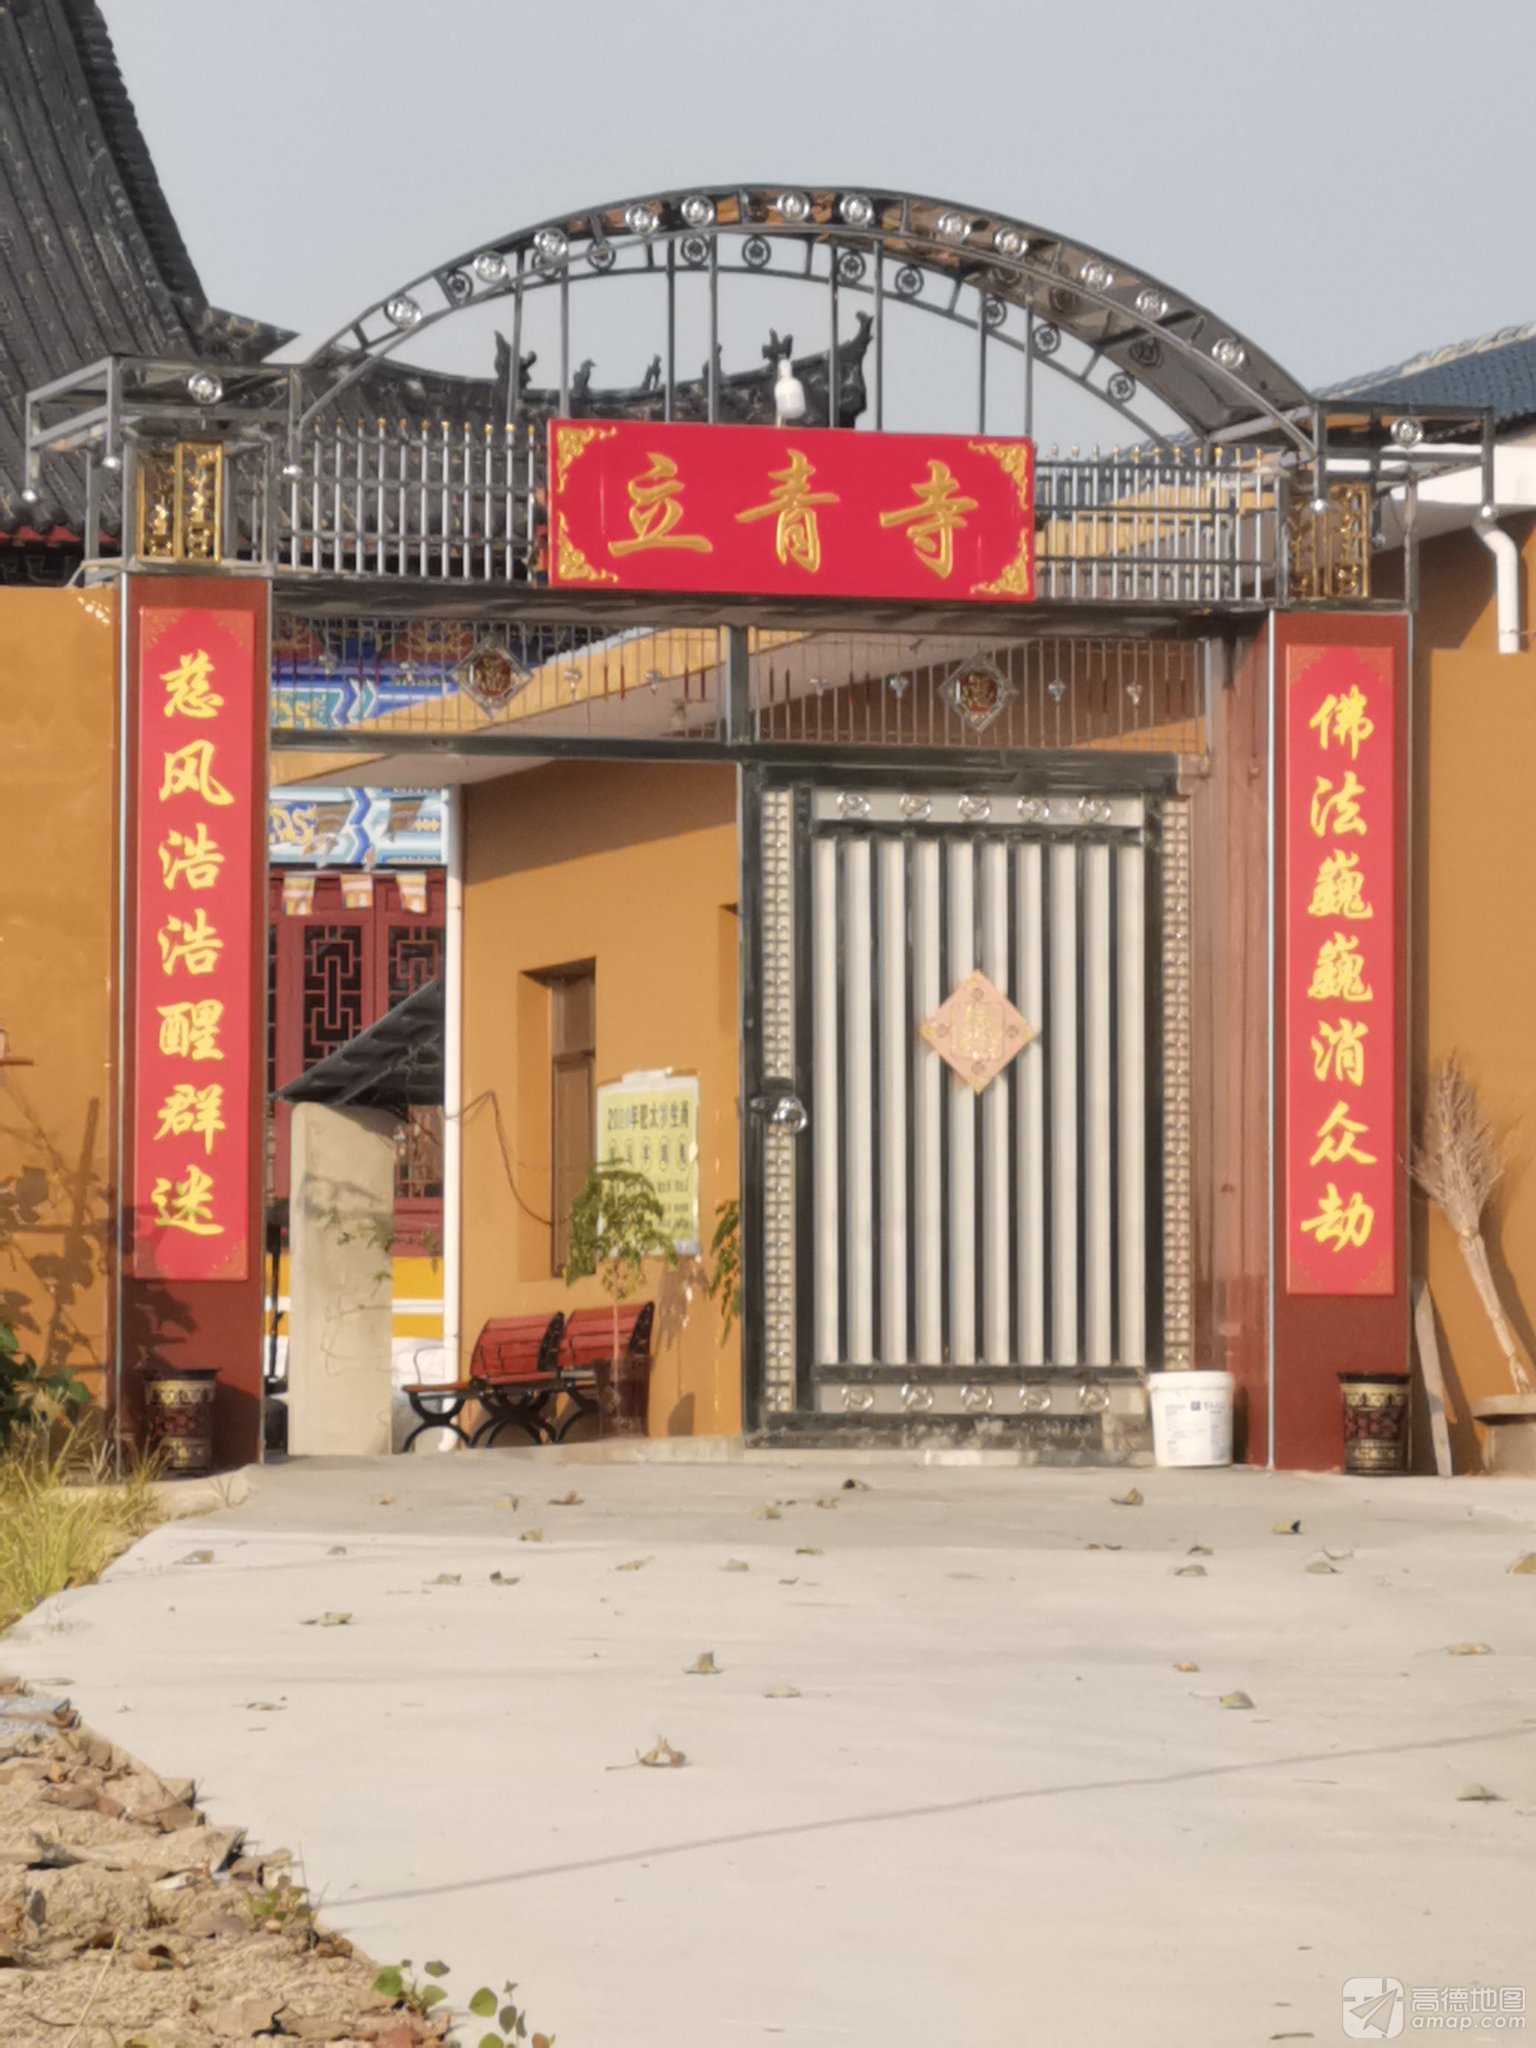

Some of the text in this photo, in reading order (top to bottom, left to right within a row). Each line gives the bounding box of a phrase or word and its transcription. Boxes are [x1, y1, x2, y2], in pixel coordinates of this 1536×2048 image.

[607, 449, 979, 578] 立青寺
[152, 649, 235, 1236] 慈风浩浩醒群迷
[1300, 684, 1379, 1252] 佛法巍巍消众劫
